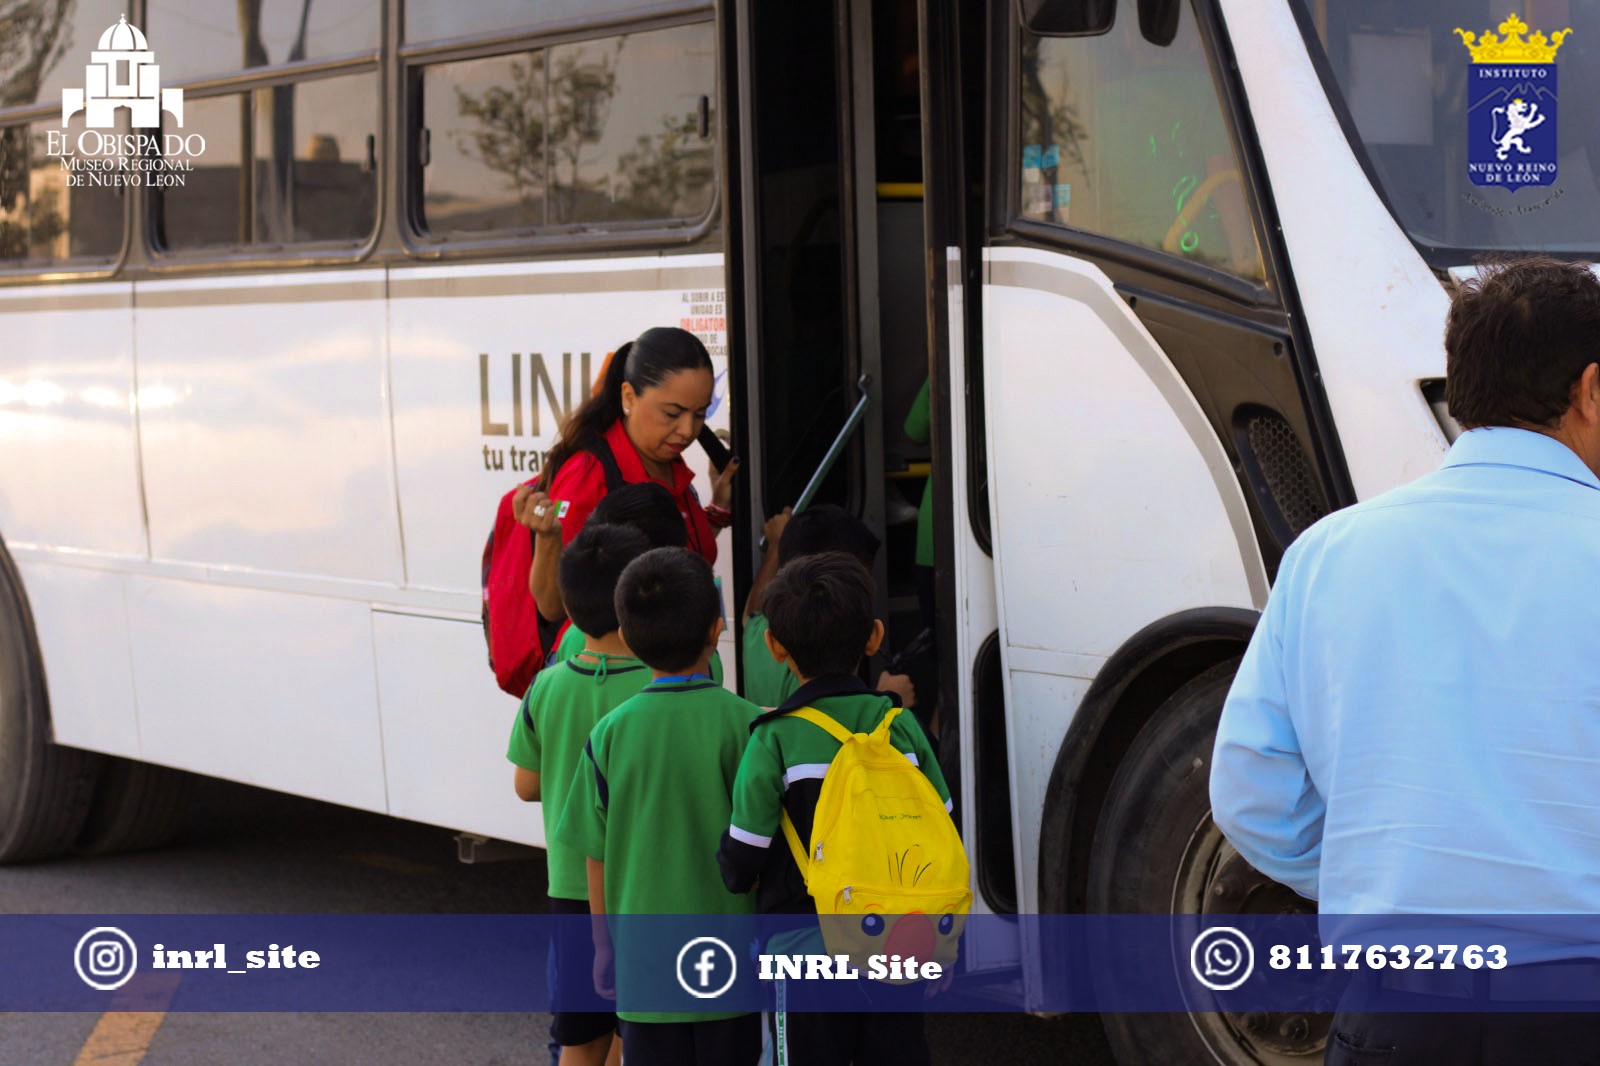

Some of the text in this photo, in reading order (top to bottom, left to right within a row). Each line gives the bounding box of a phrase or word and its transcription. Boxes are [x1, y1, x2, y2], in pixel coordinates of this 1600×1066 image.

[716, 291, 726, 302] ES
[680, 317, 726, 332] OBLIGATOR
[483, 444, 505, 471] tu
